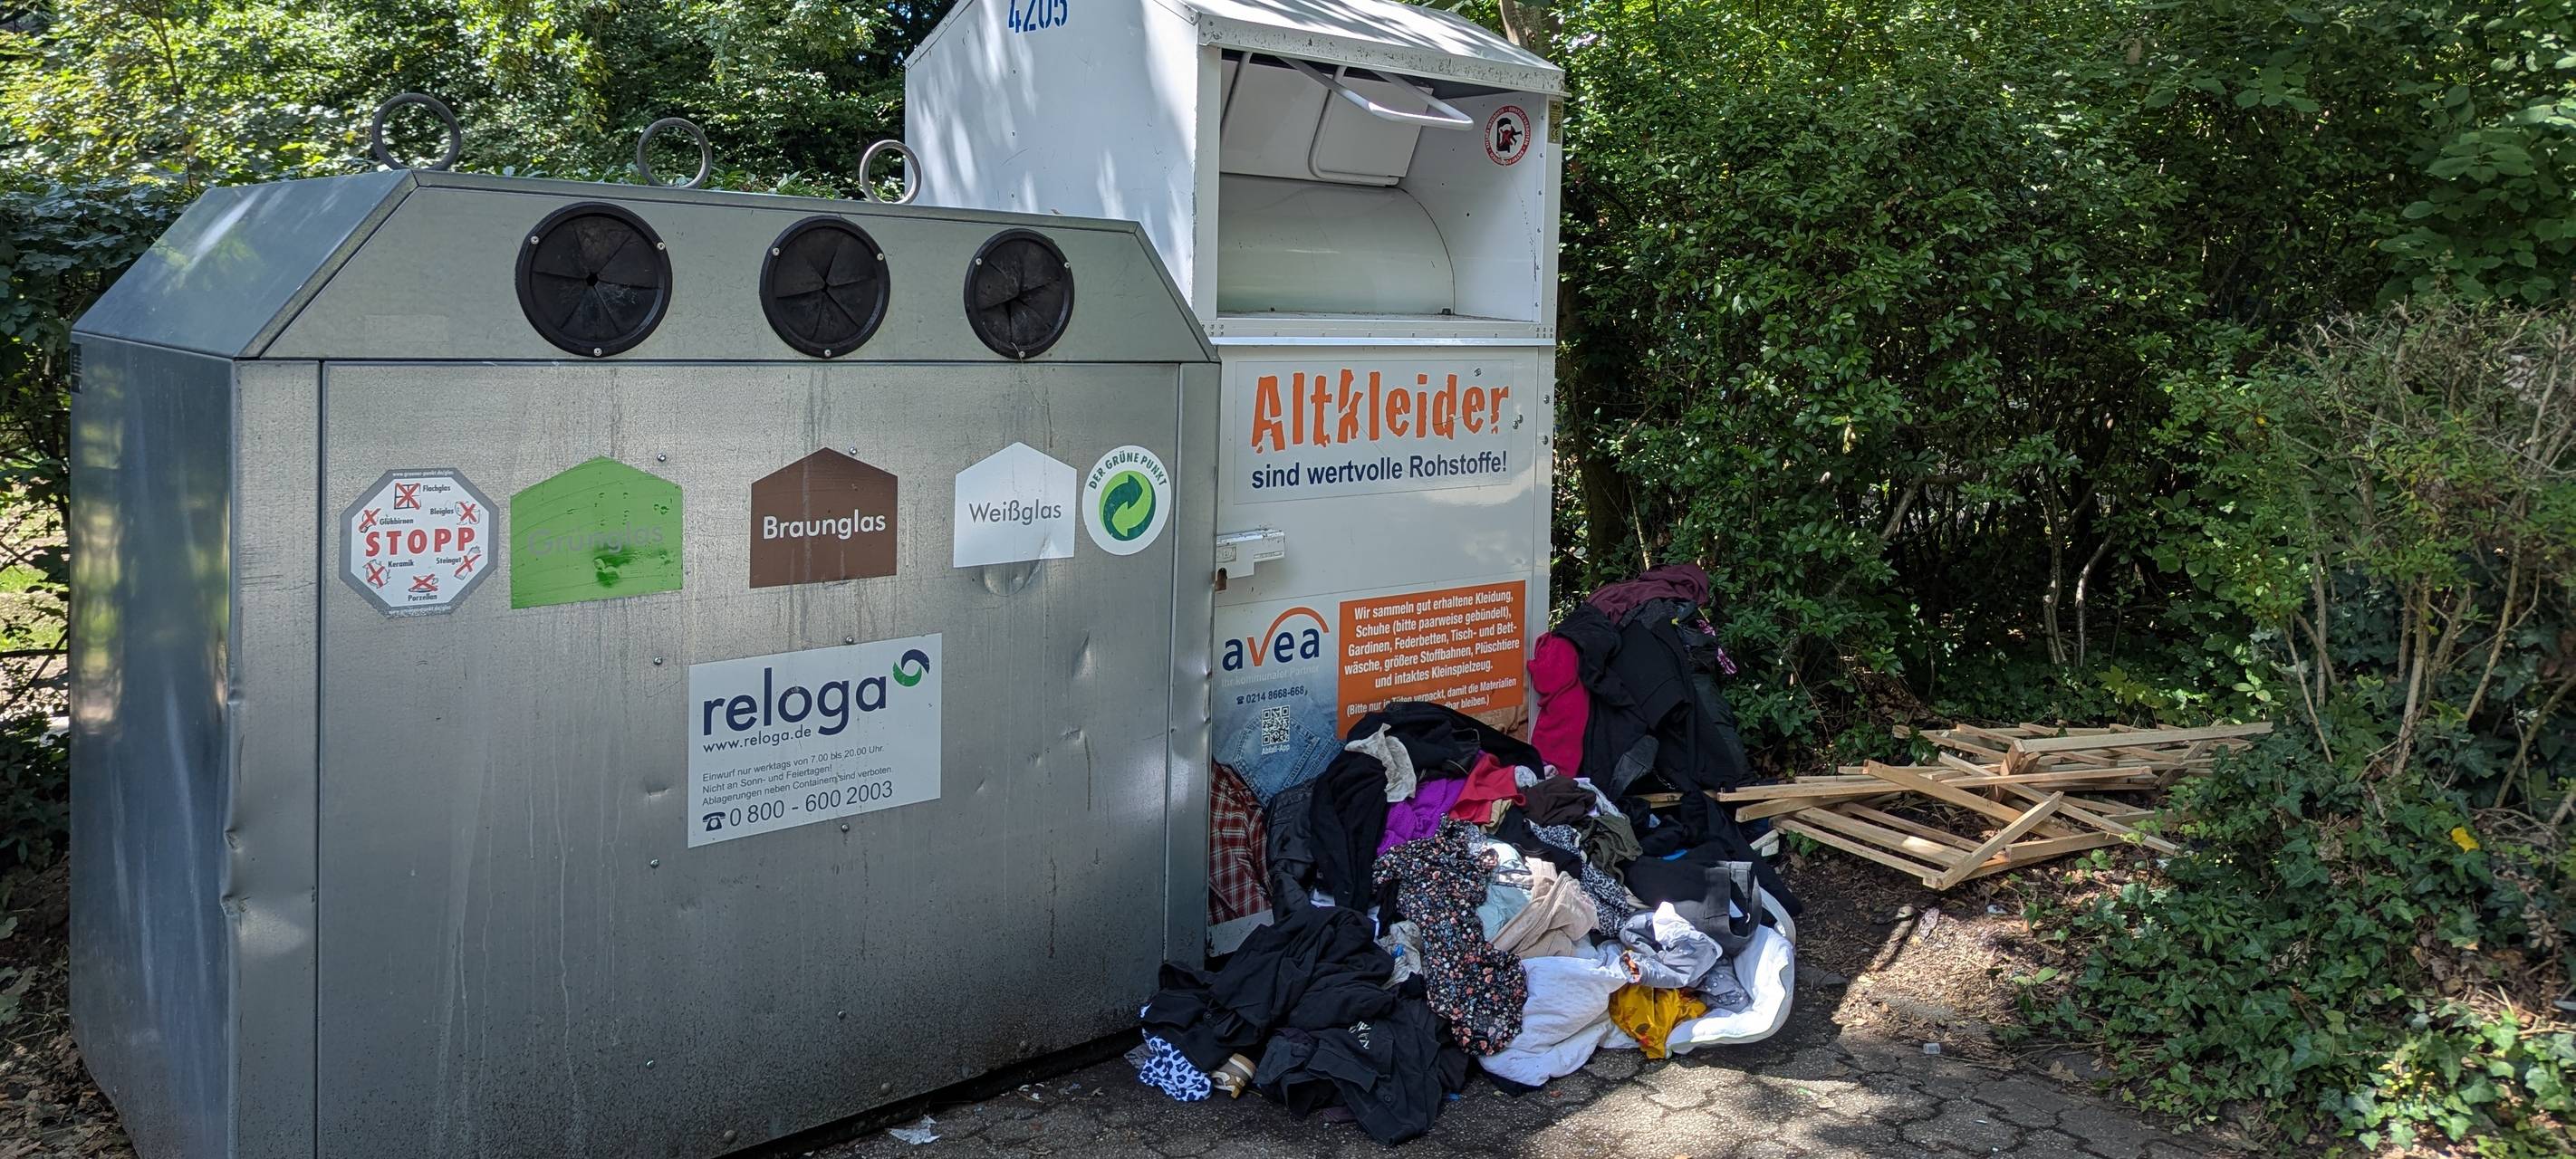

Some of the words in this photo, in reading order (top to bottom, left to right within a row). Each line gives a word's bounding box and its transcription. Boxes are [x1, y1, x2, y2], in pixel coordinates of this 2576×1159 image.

[1008, 0, 1068, 33] 4205
[1251, 369, 1509, 453] Altkleider
[1089, 467, 1106, 490] DER
[1105, 450, 1139, 470] GRÜNE
[1140, 455, 1167, 486] PUNKT
[1251, 462, 1300, 489] sind
[1307, 456, 1403, 485] wertvolle
[1409, 450, 1507, 478] Rohstoffe!
[422, 484, 451, 493] Flachglas
[380, 517, 414, 525] Glühbirnen
[429, 507, 454, 516] Bleiglas
[764, 509, 886, 540] Braunglas
[969, 499, 1062, 525] Weißglas
[365, 527, 476, 557] STOPP
[528, 522, 664, 556] Grünglas
[388, 559, 414, 568] Keramik
[436, 557, 462, 565] Steingut
[408, 594, 437, 602] Porzellan
[1354, 607, 1371, 620] Wir
[1372, 601, 1414, 618] sammeln
[1417, 599, 1431, 615] gut
[1433, 594, 1474, 610] erhaltene
[1475, 589, 1514, 605] Kleidung,
[1356, 621, 1390, 637] Schuhe
[1393, 618, 1417, 636] (bitte
[1418, 613, 1463, 631] paarweise
[1465, 605, 1512, 625] gebündelt),
[1222, 612, 1328, 671] avea
[1348, 639, 1392, 657] Gardinen,
[1395, 633, 1449, 650] Federbetten,
[1451, 626, 1476, 641] Tisch-
[1479, 625, 1495, 637] und
[1497, 622, 1517, 635] Bett-
[1344, 660, 1382, 675] wäsche,
[1384, 656, 1418, 672] größere
[1420, 646, 1473, 664] Stoffbahnen,
[1475, 638, 1520, 656] Plüschtiere
[1235, 669, 1287, 685] kommunaler
[1290, 665, 1320, 677] Partner
[1375, 673, 1392, 689] und
[1394, 669, 1429, 685] intaktes
[1431, 659, 1494, 679] Kleinspielzeug.
[703, 666, 887, 736] reloga
[1245, 693, 1266, 704] 0214
[1268, 685, 1304, 701] 8668-668
[1347, 703, 1368, 717] (Bitte
[1369, 703, 1381, 712] nur
[1413, 688, 1446, 703] verpackt,
[1447, 686, 1467, 698] damit
[1468, 682, 1479, 693] die
[1480, 676, 1517, 691] Materialien
[1460, 694, 1490, 709] bleiben.)
[702, 724, 812, 753] www.reloga.de
[702, 769, 736, 782] Einwurf
[737, 767, 752, 777] nur
[754, 761, 791, 775] werktags
[793, 758, 808, 768] von
[811, 752, 829, 764] 7.00
[831, 752, 842, 761] bis
[844, 746, 867, 758] 20.00
[702, 781, 726, 795] Nicht
[726, 781, 738, 790] an
[740, 776, 766, 788] Sonn-
[769, 773, 784, 783] und
[786, 765, 832, 781] Feiertagen!
[702, 788, 762, 807] Ablagerungen
[764, 783, 791, 794] neben
[793, 775, 838, 790] Containern
[839, 771, 856, 781] sind
[729, 807, 742, 827] 0
[747, 800, 784, 823] 800
[805, 789, 841, 812] 600
[846, 780, 893, 805] 2003
